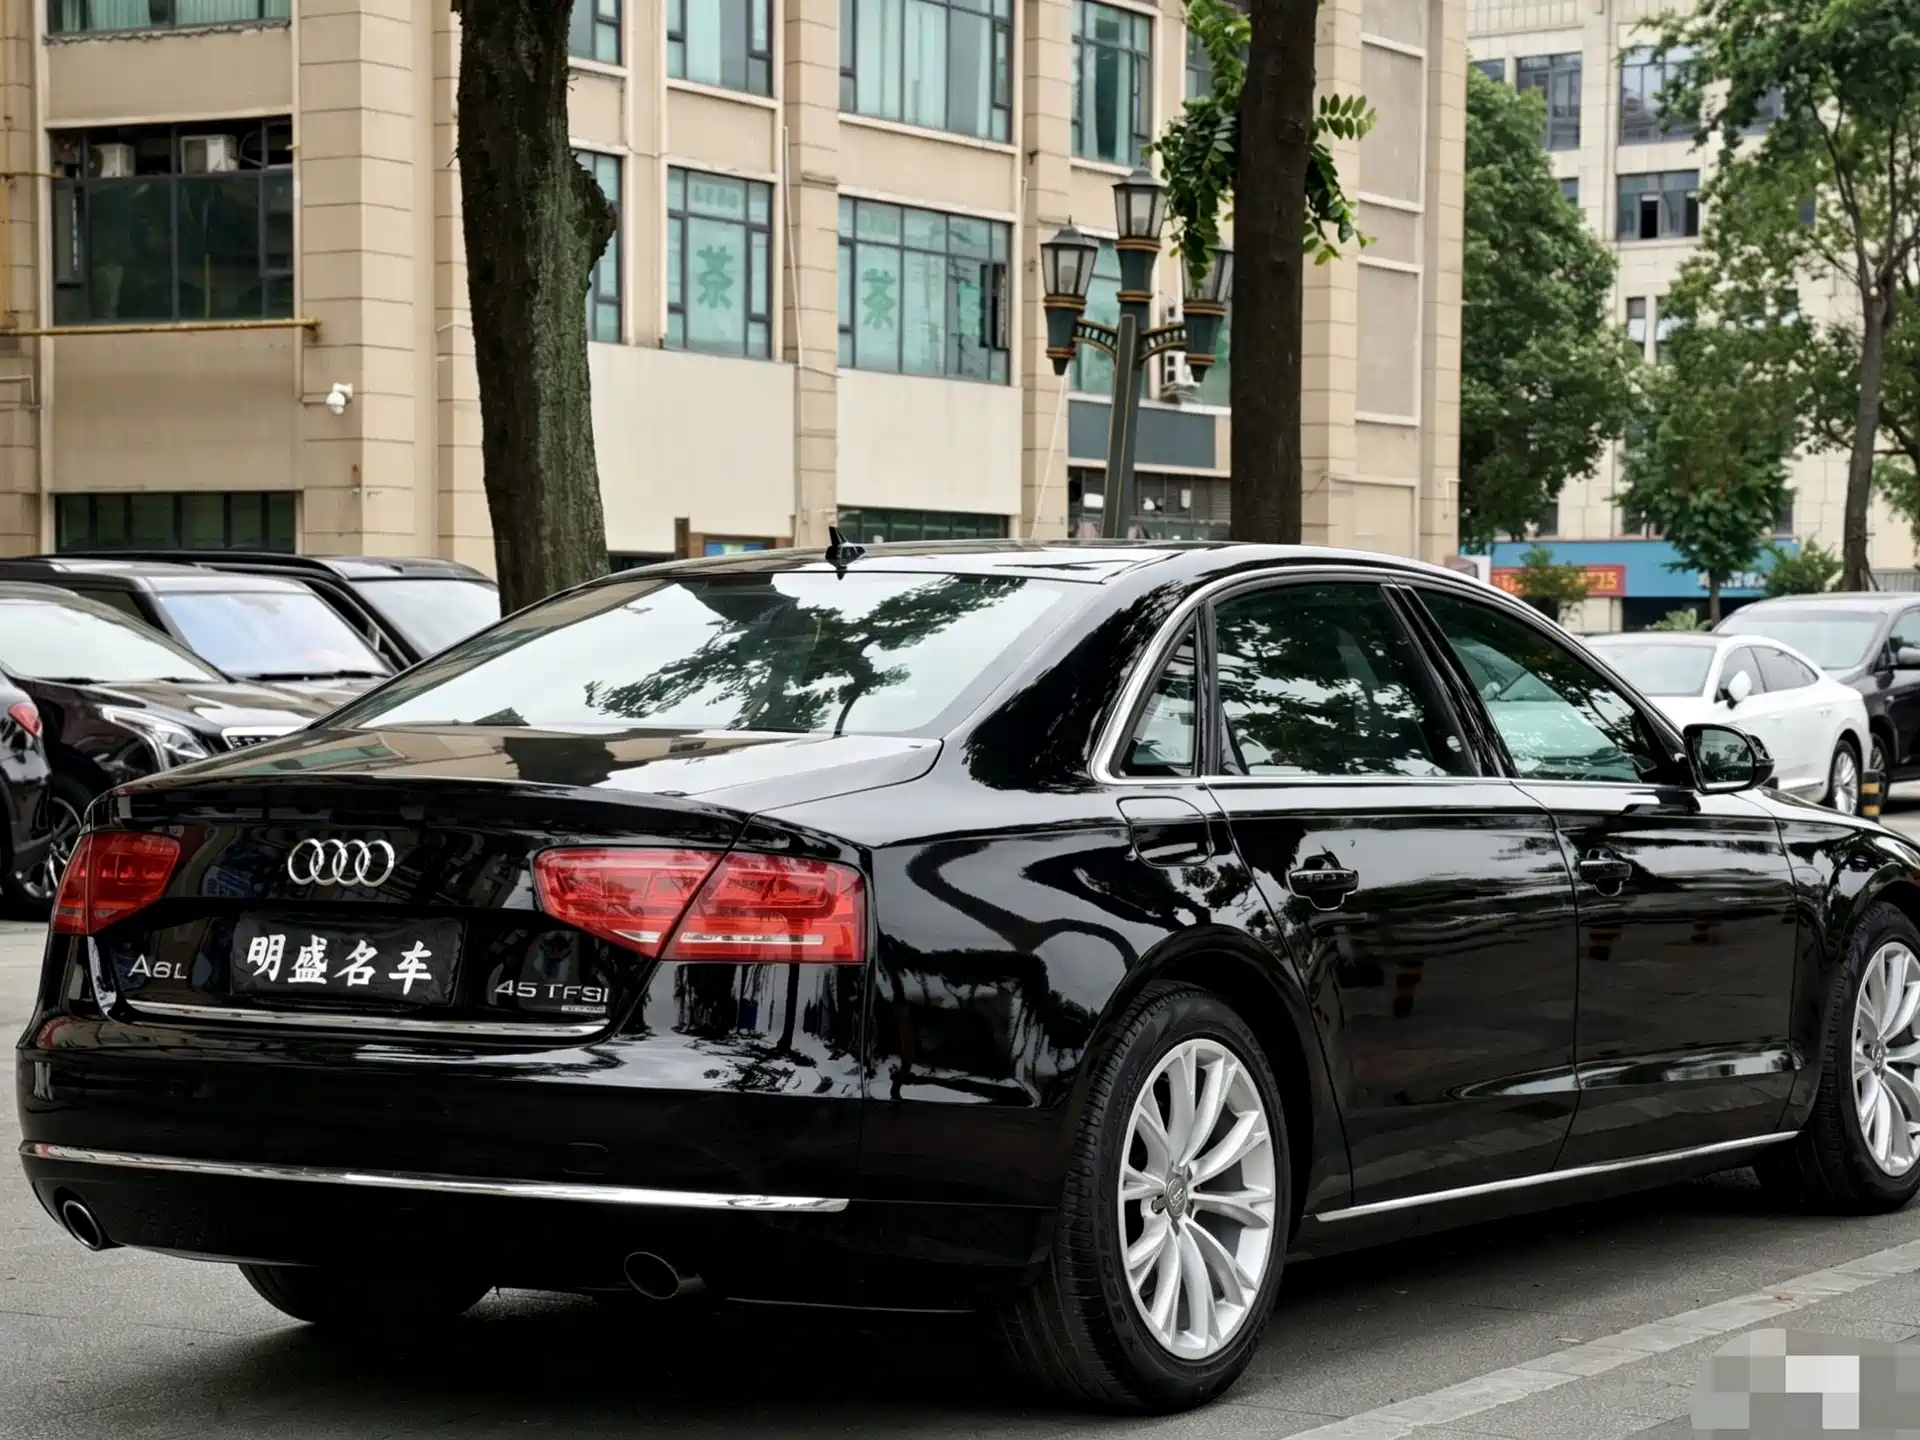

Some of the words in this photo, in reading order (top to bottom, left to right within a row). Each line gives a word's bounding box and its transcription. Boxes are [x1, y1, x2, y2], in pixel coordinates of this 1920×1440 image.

[246, 933, 433, 996] 明盛名车
[494, 979, 538, 998] 45
[543, 983, 610, 1003] TFSI
